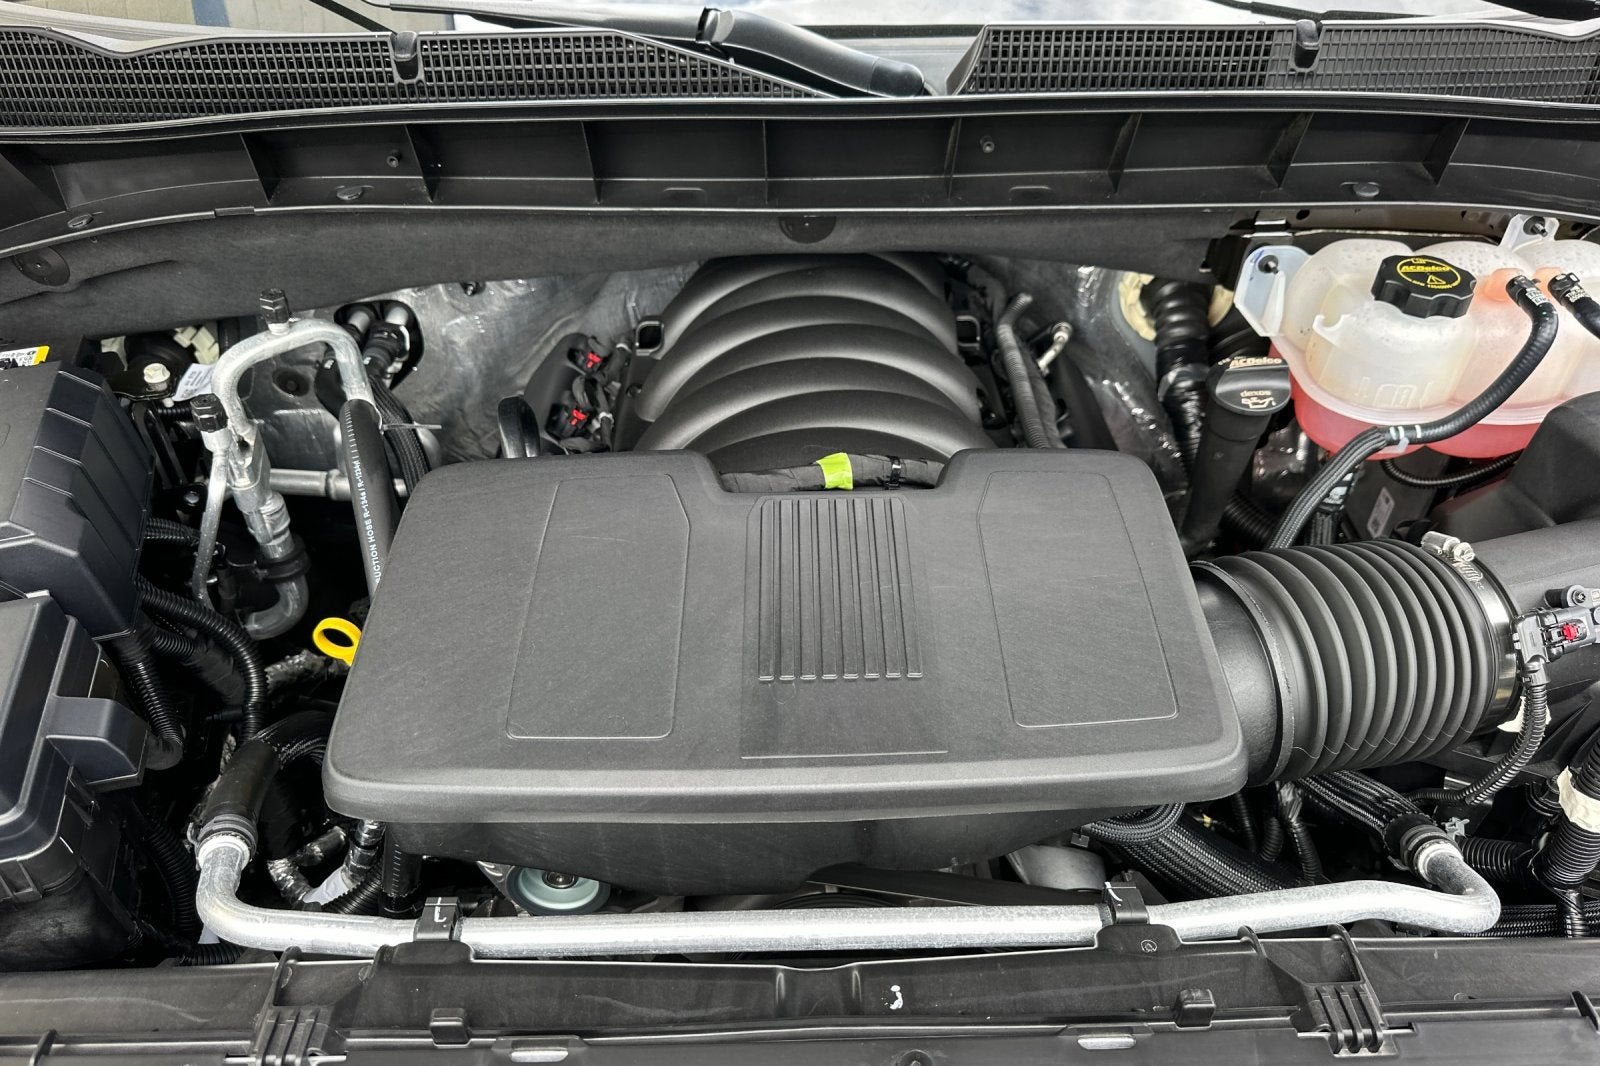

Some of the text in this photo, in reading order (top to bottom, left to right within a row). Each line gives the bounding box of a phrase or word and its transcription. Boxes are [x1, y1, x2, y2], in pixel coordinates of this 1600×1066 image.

[1400, 265, 1450, 273] ACDelco
[1229, 357, 1282, 368] ACDelco
[365, 519, 375, 542] HOSE
